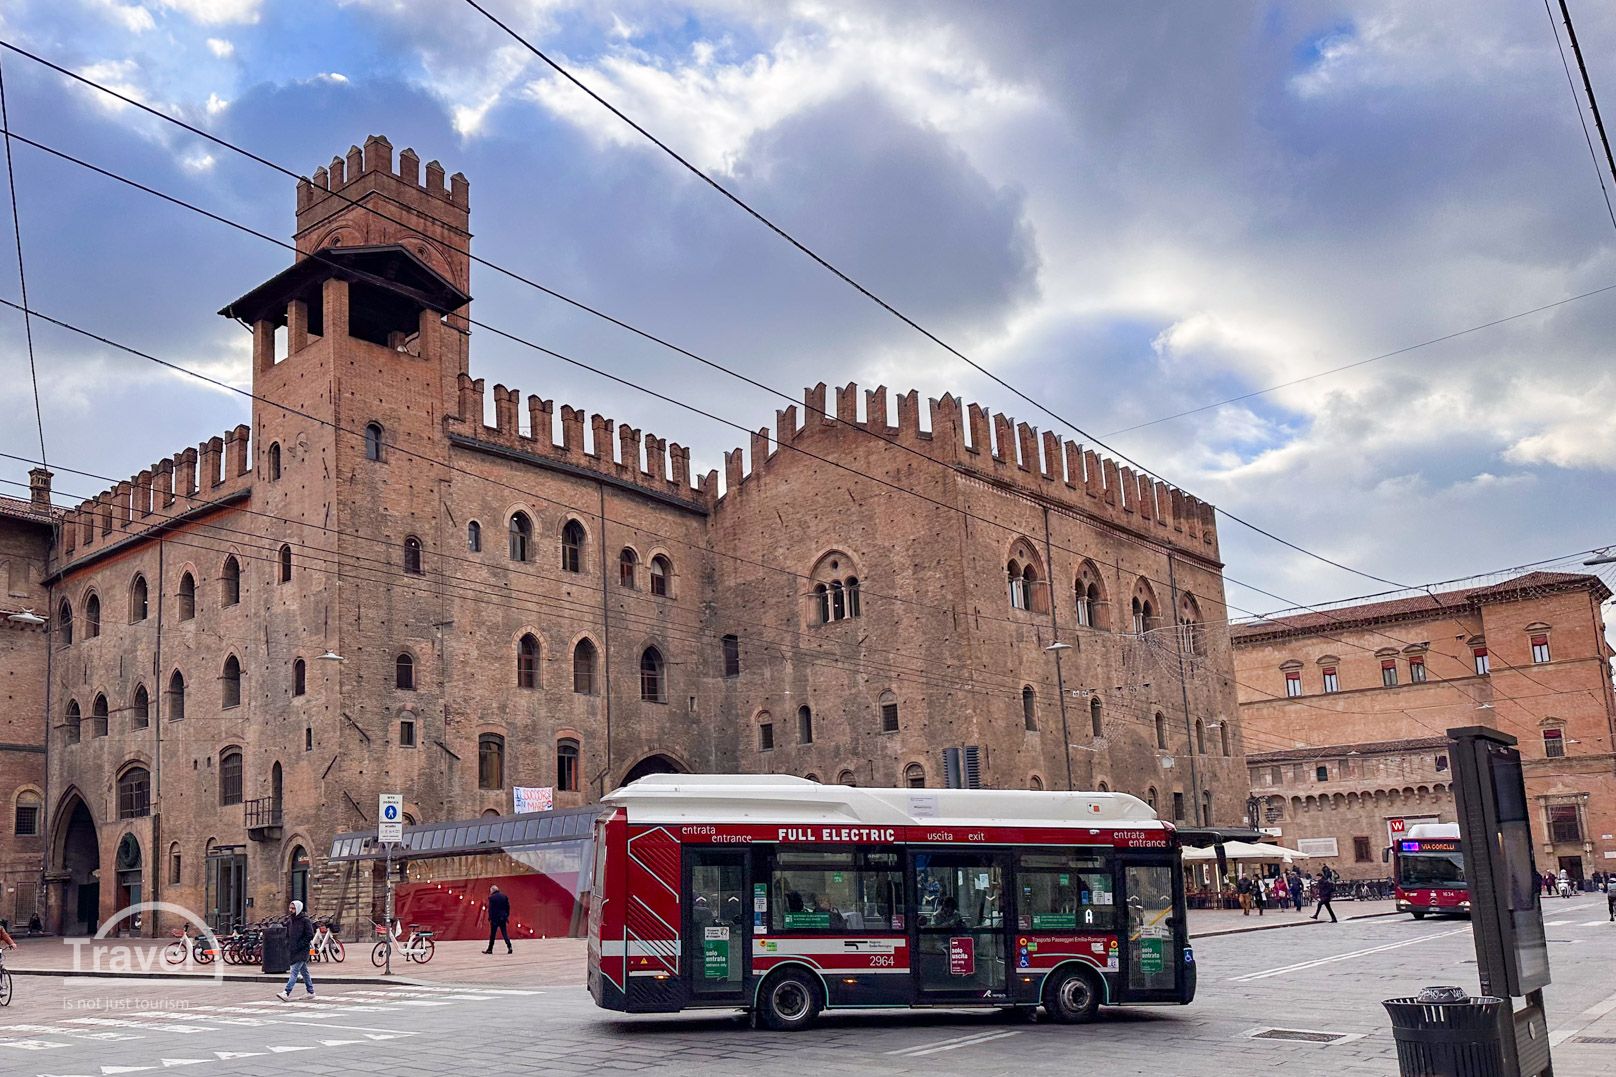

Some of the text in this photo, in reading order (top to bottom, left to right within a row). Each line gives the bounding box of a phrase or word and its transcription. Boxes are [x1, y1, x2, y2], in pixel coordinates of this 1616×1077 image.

[682, 826, 716, 835] entrata
[1392, 821, 1403, 831] W
[712, 834, 752, 843] entrance
[778, 829, 895, 841] FULL ELECTRIC
[927, 831, 985, 841] uscita exit
[1113, 830, 1145, 839] entrata
[1128, 838, 1166, 848] entrance
[869, 956, 895, 967] 2964
